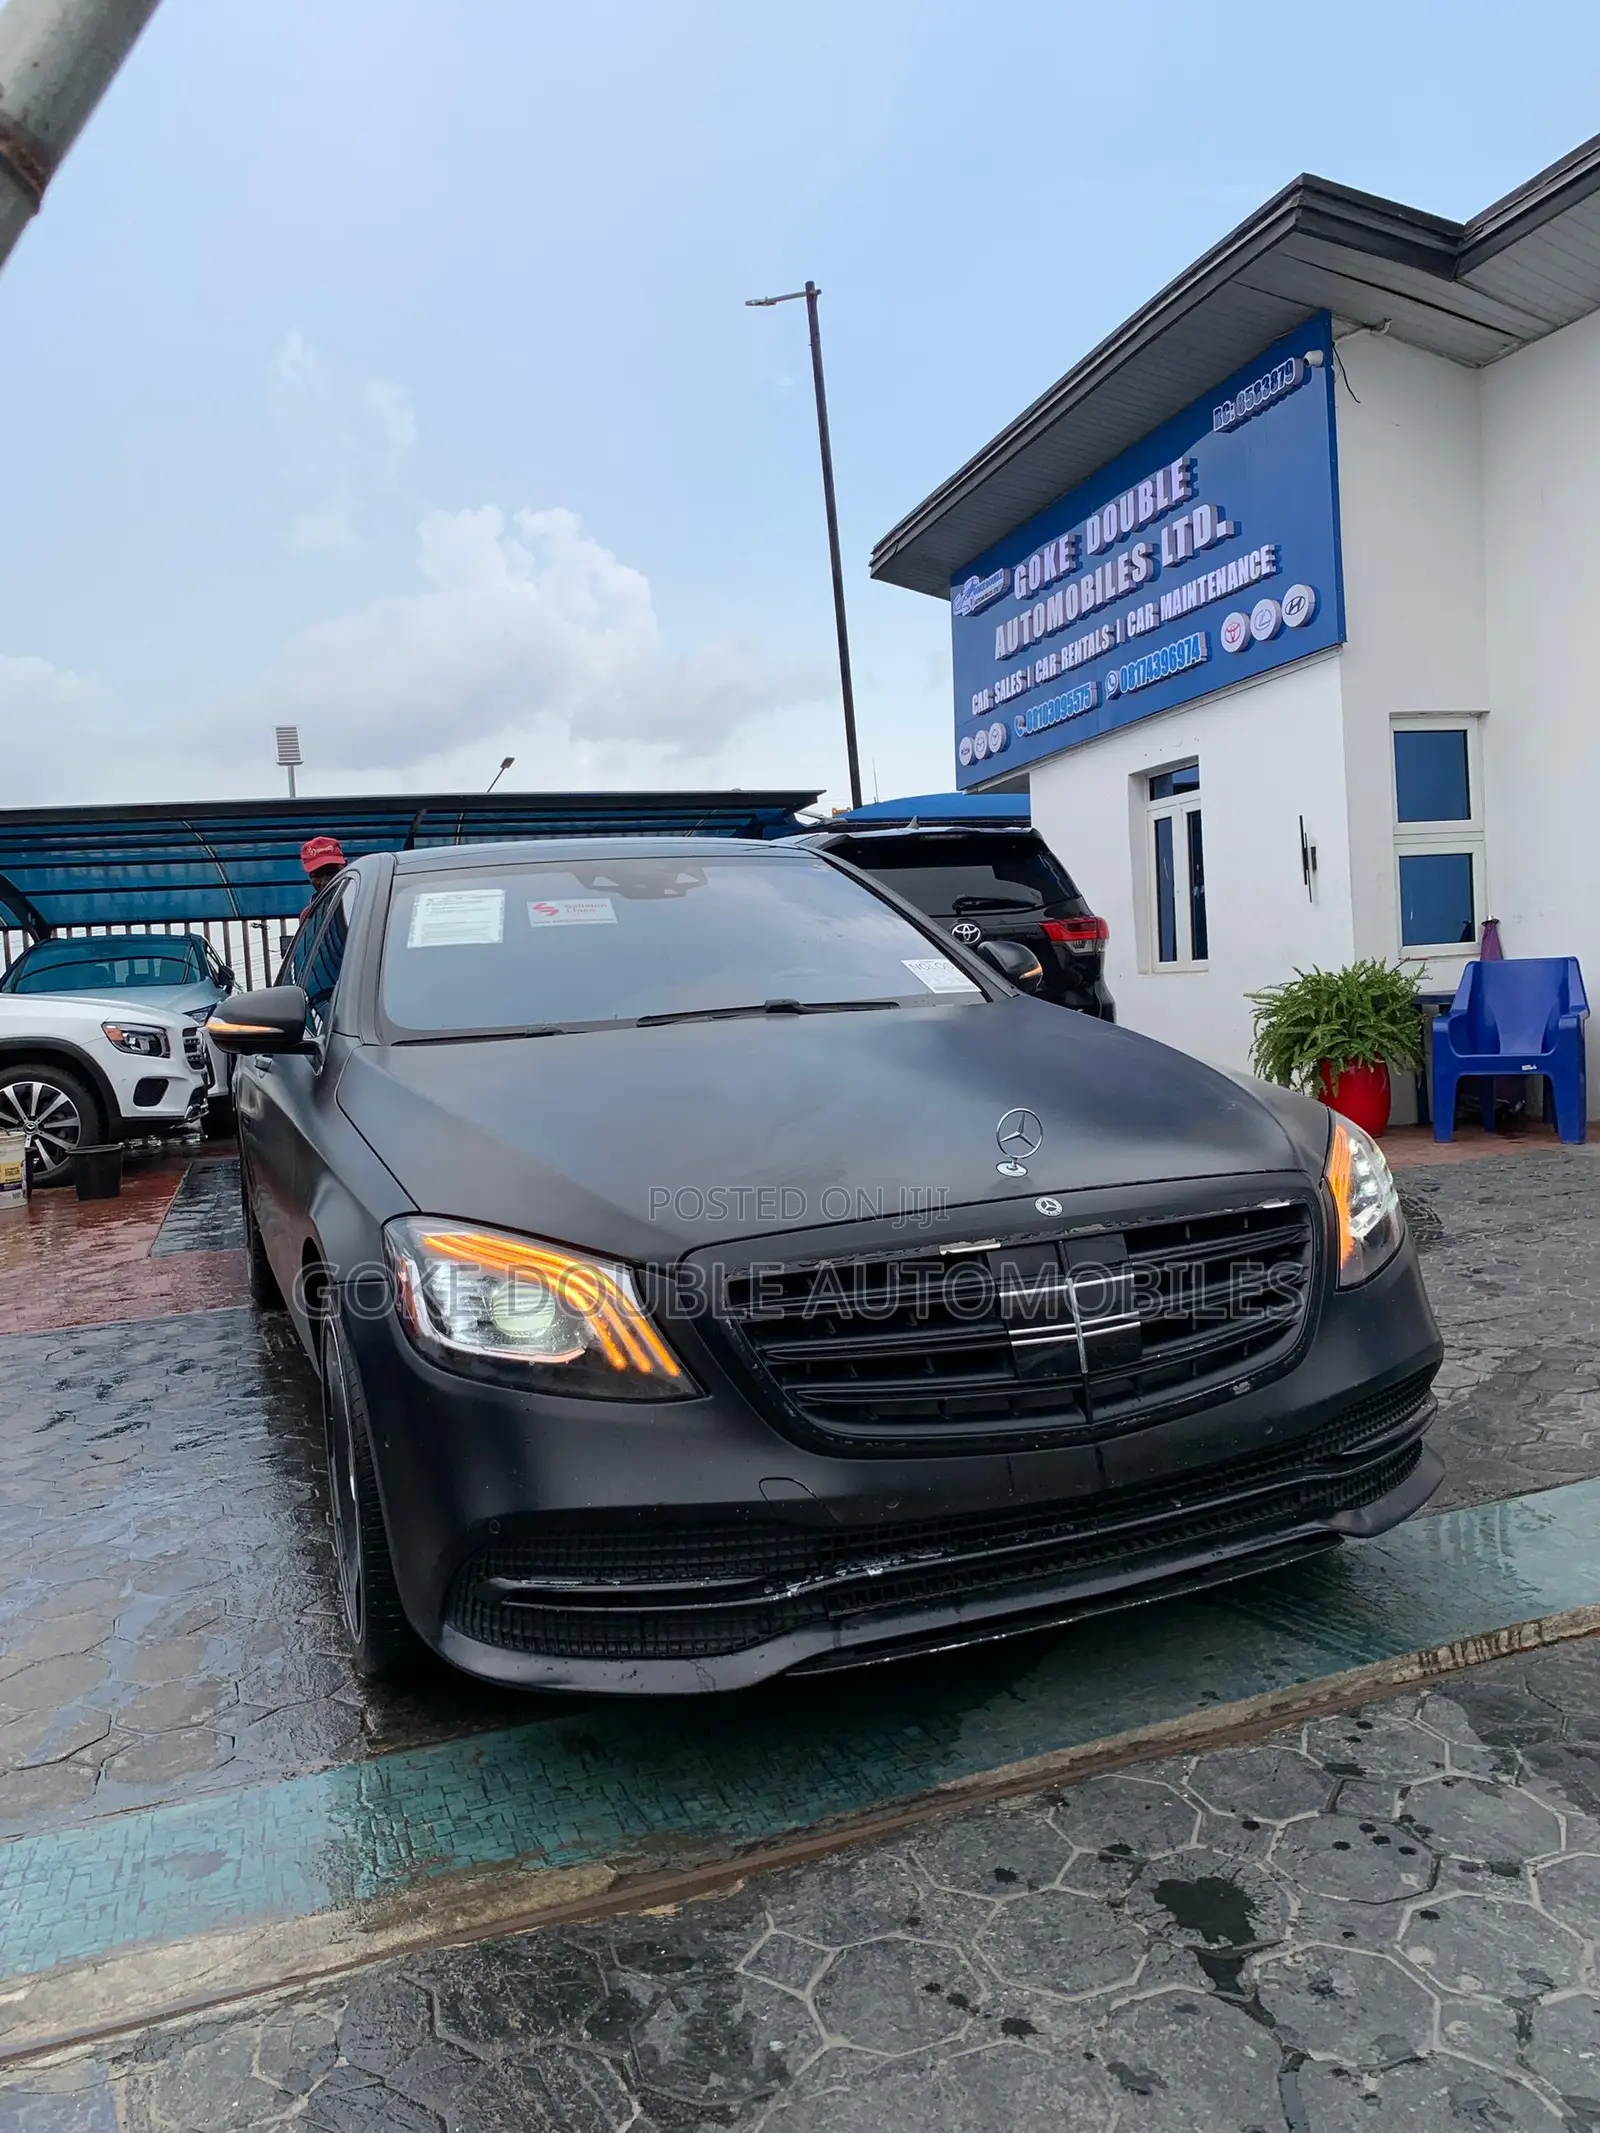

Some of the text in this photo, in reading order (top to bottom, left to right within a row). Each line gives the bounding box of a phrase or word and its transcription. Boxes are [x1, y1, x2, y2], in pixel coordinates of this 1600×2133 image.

[1212, 400, 1236, 432] RC:
[994, 504, 1229, 661] AUTOMOBILES LTD.
[1013, 456, 1188, 600] GOKE DOUBLE
[972, 688, 991, 716] CAR
[994, 669, 1024, 704] SALES
[1035, 653, 1058, 683] CAR
[1061, 624, 1110, 671] RENTALS
[1127, 602, 1155, 637] CAR
[1160, 544, 1276, 622] MAINTENANCE
[1119, 632, 1202, 694] 08174396974
